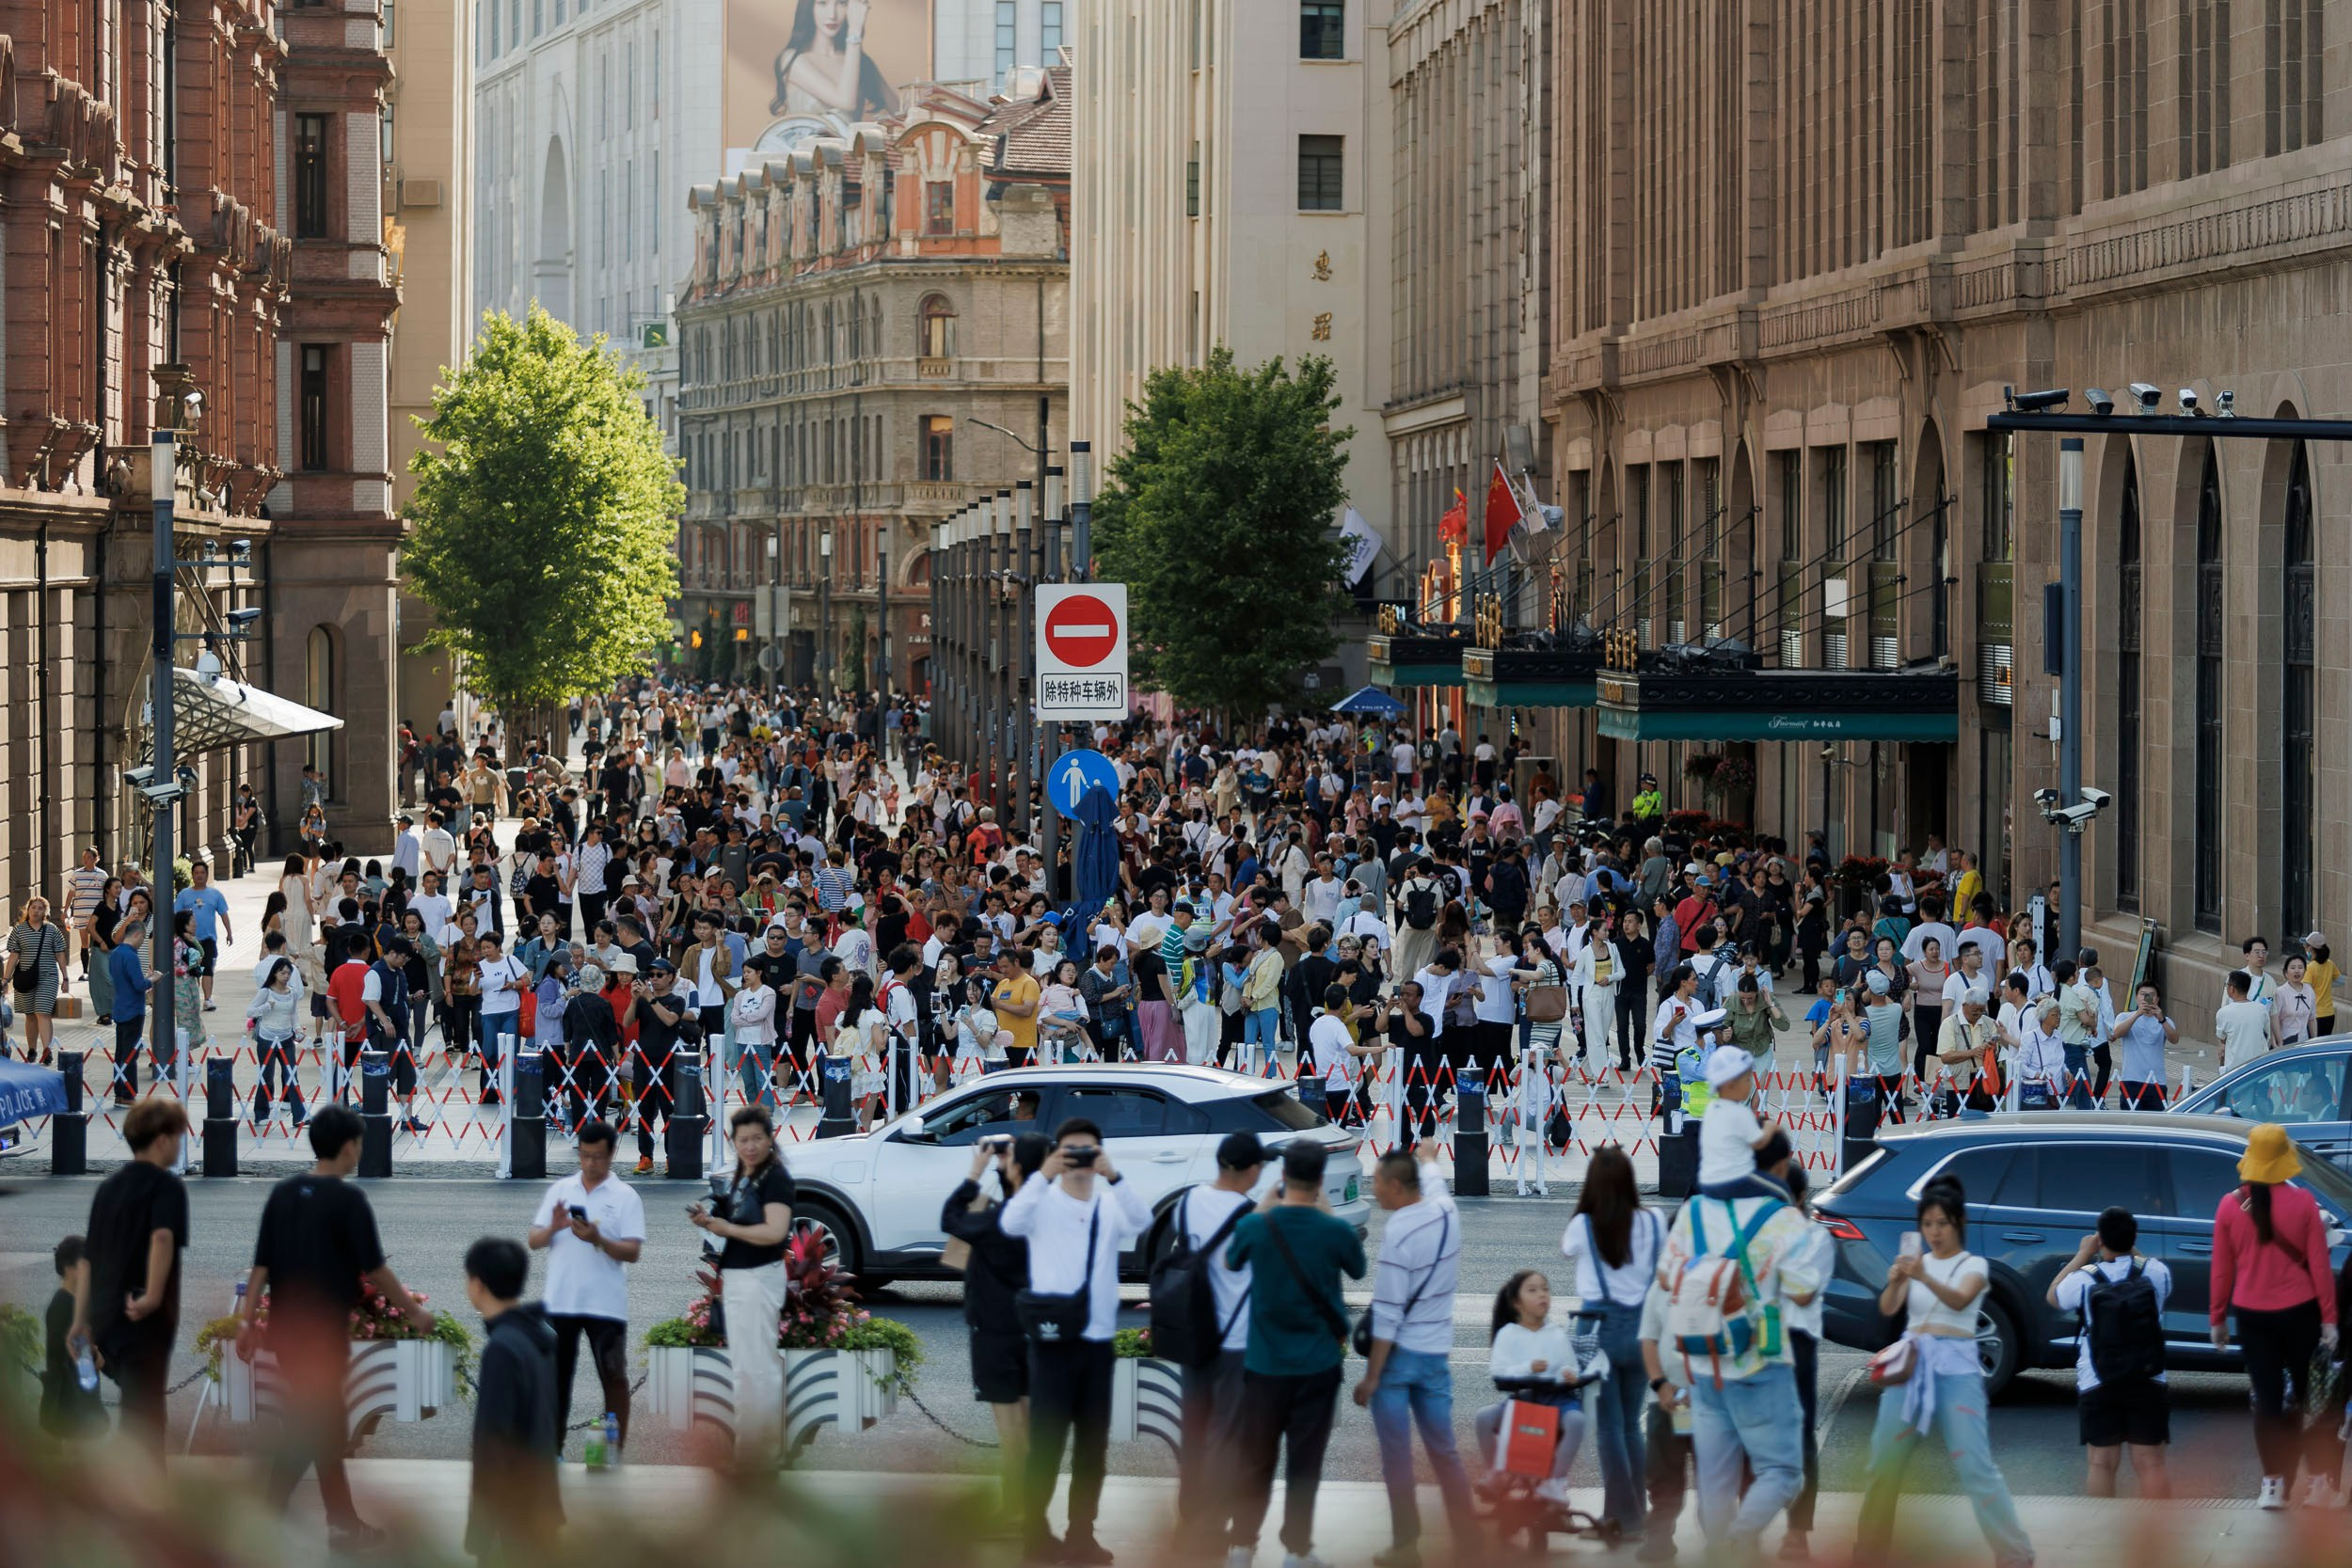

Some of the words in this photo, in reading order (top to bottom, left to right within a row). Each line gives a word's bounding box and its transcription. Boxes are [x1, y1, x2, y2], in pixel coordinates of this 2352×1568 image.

[1045, 680, 1119, 703] 除特种车辆外
